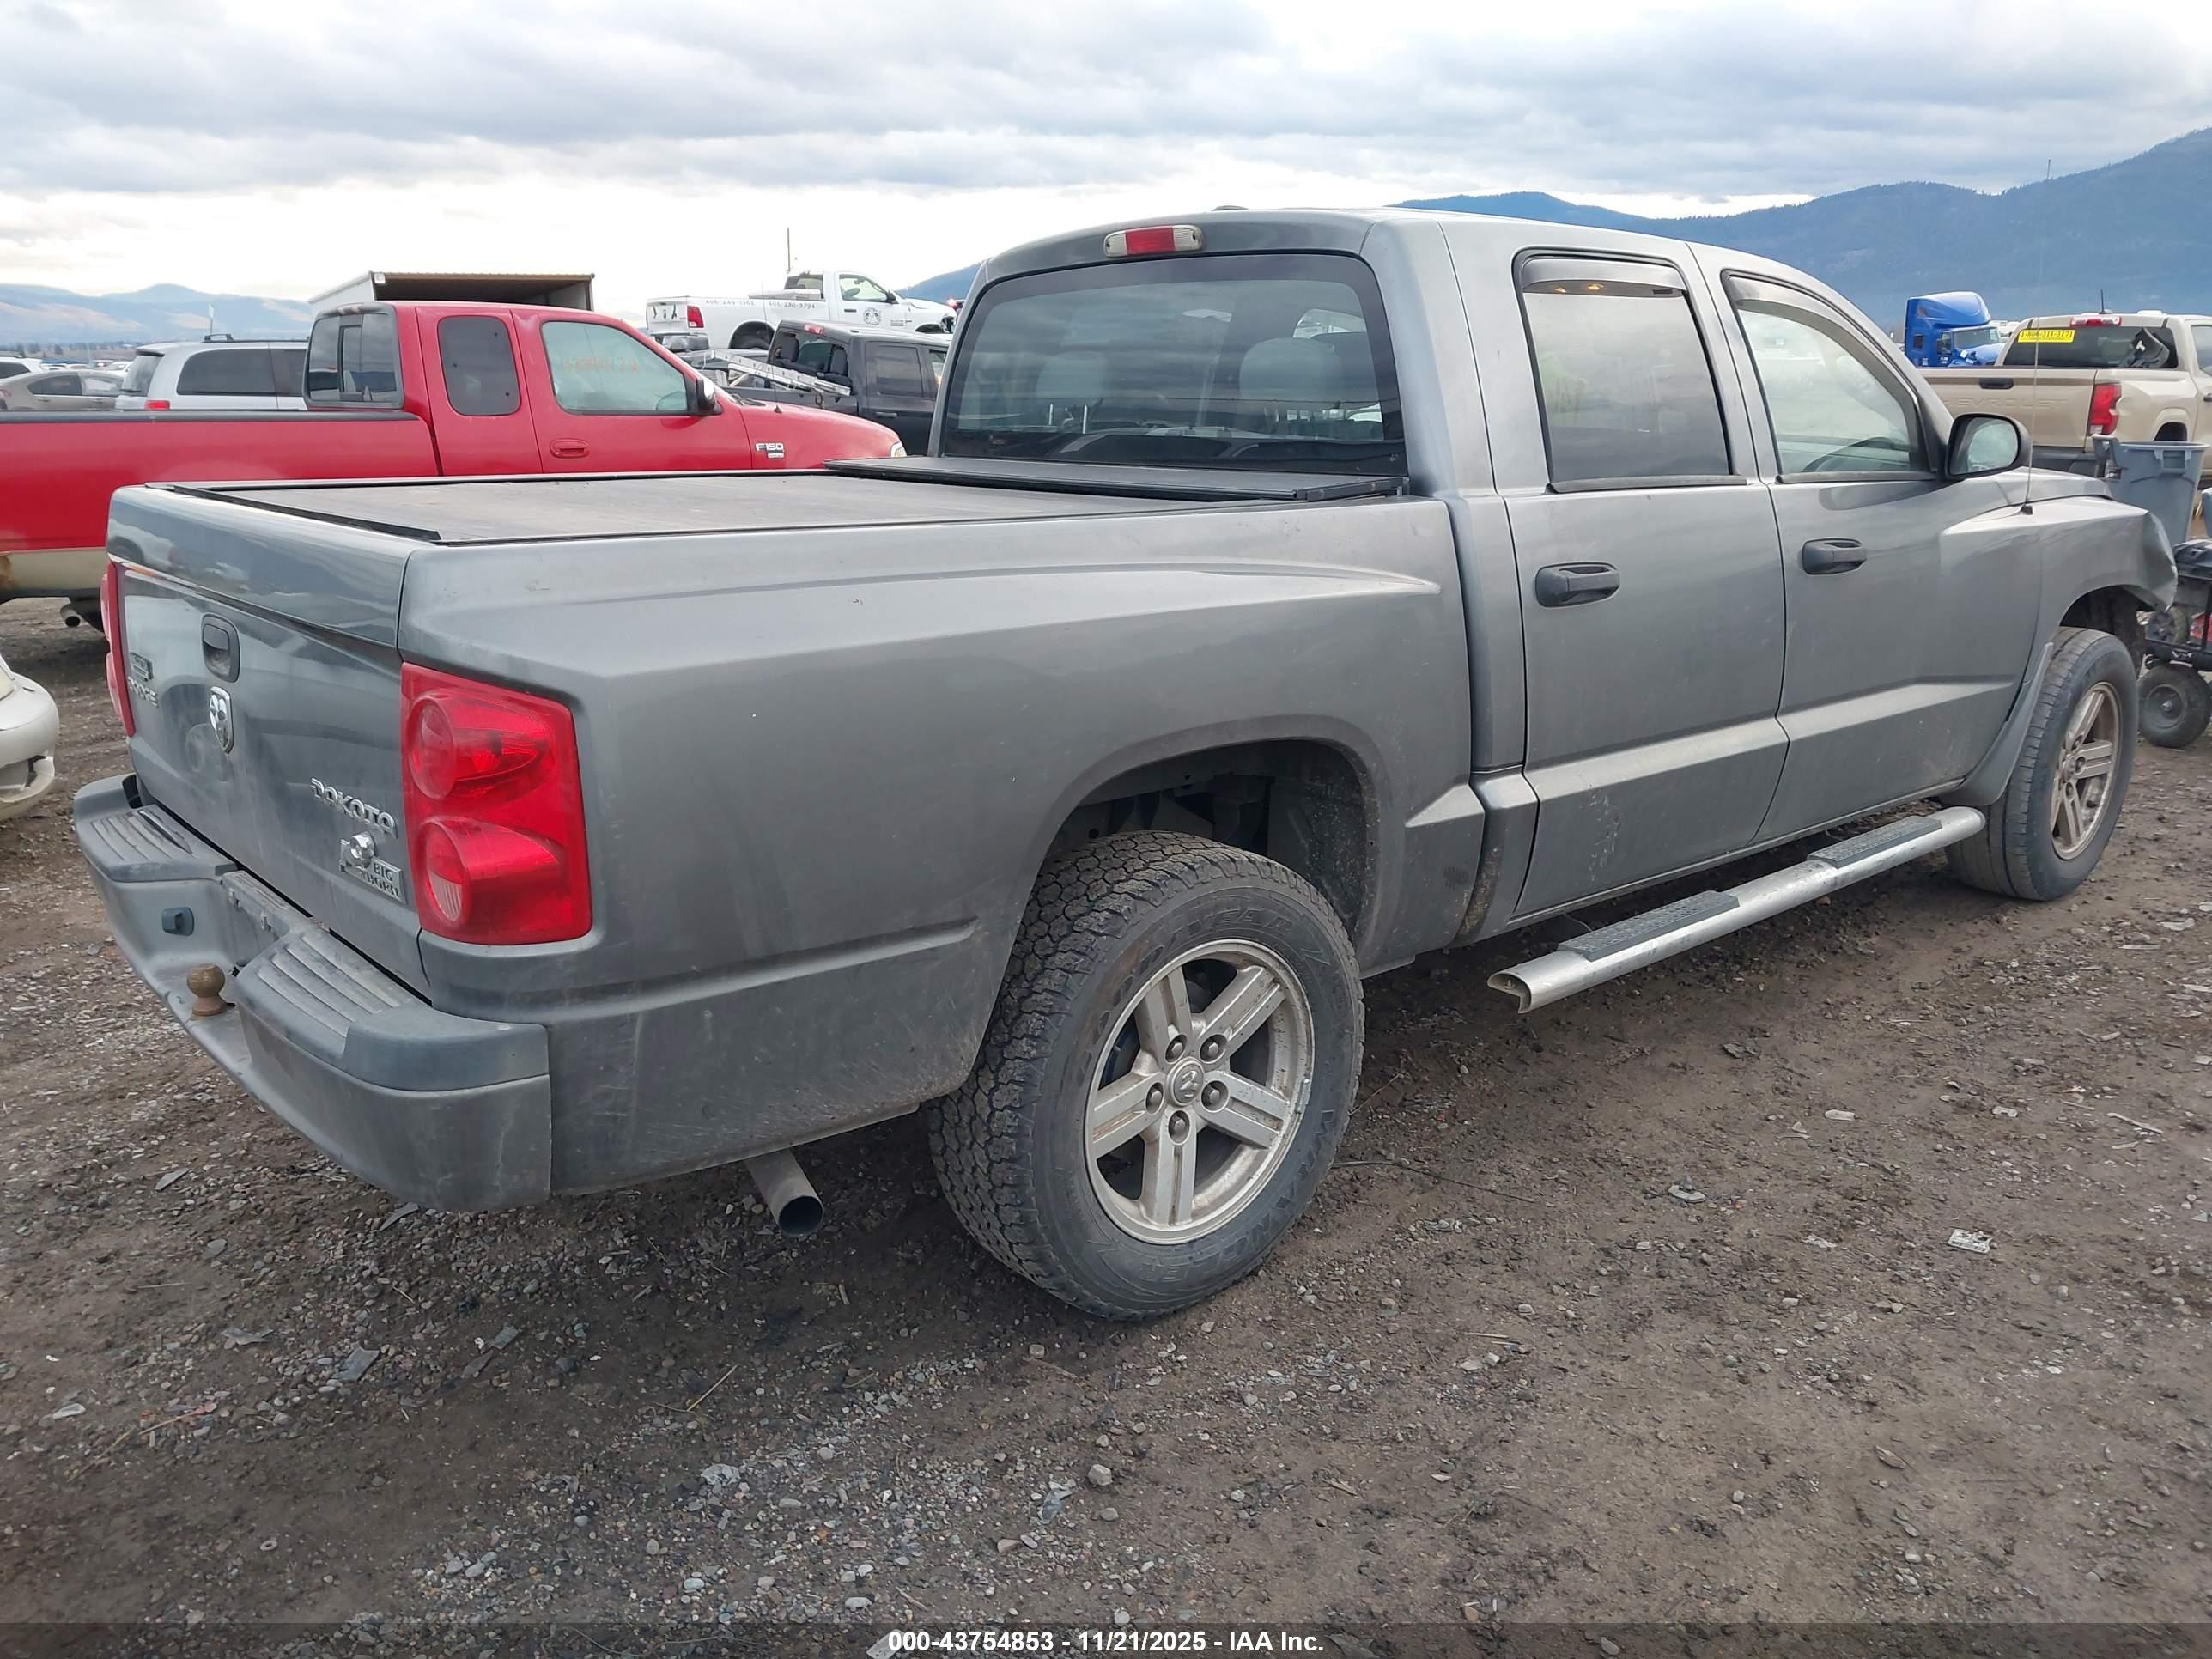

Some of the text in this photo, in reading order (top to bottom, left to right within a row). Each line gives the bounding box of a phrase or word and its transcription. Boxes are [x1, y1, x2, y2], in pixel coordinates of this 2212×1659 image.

[309, 777, 397, 836] DAKOTA
[365, 871, 400, 898] HORN
[374, 862, 393, 882] BIG
